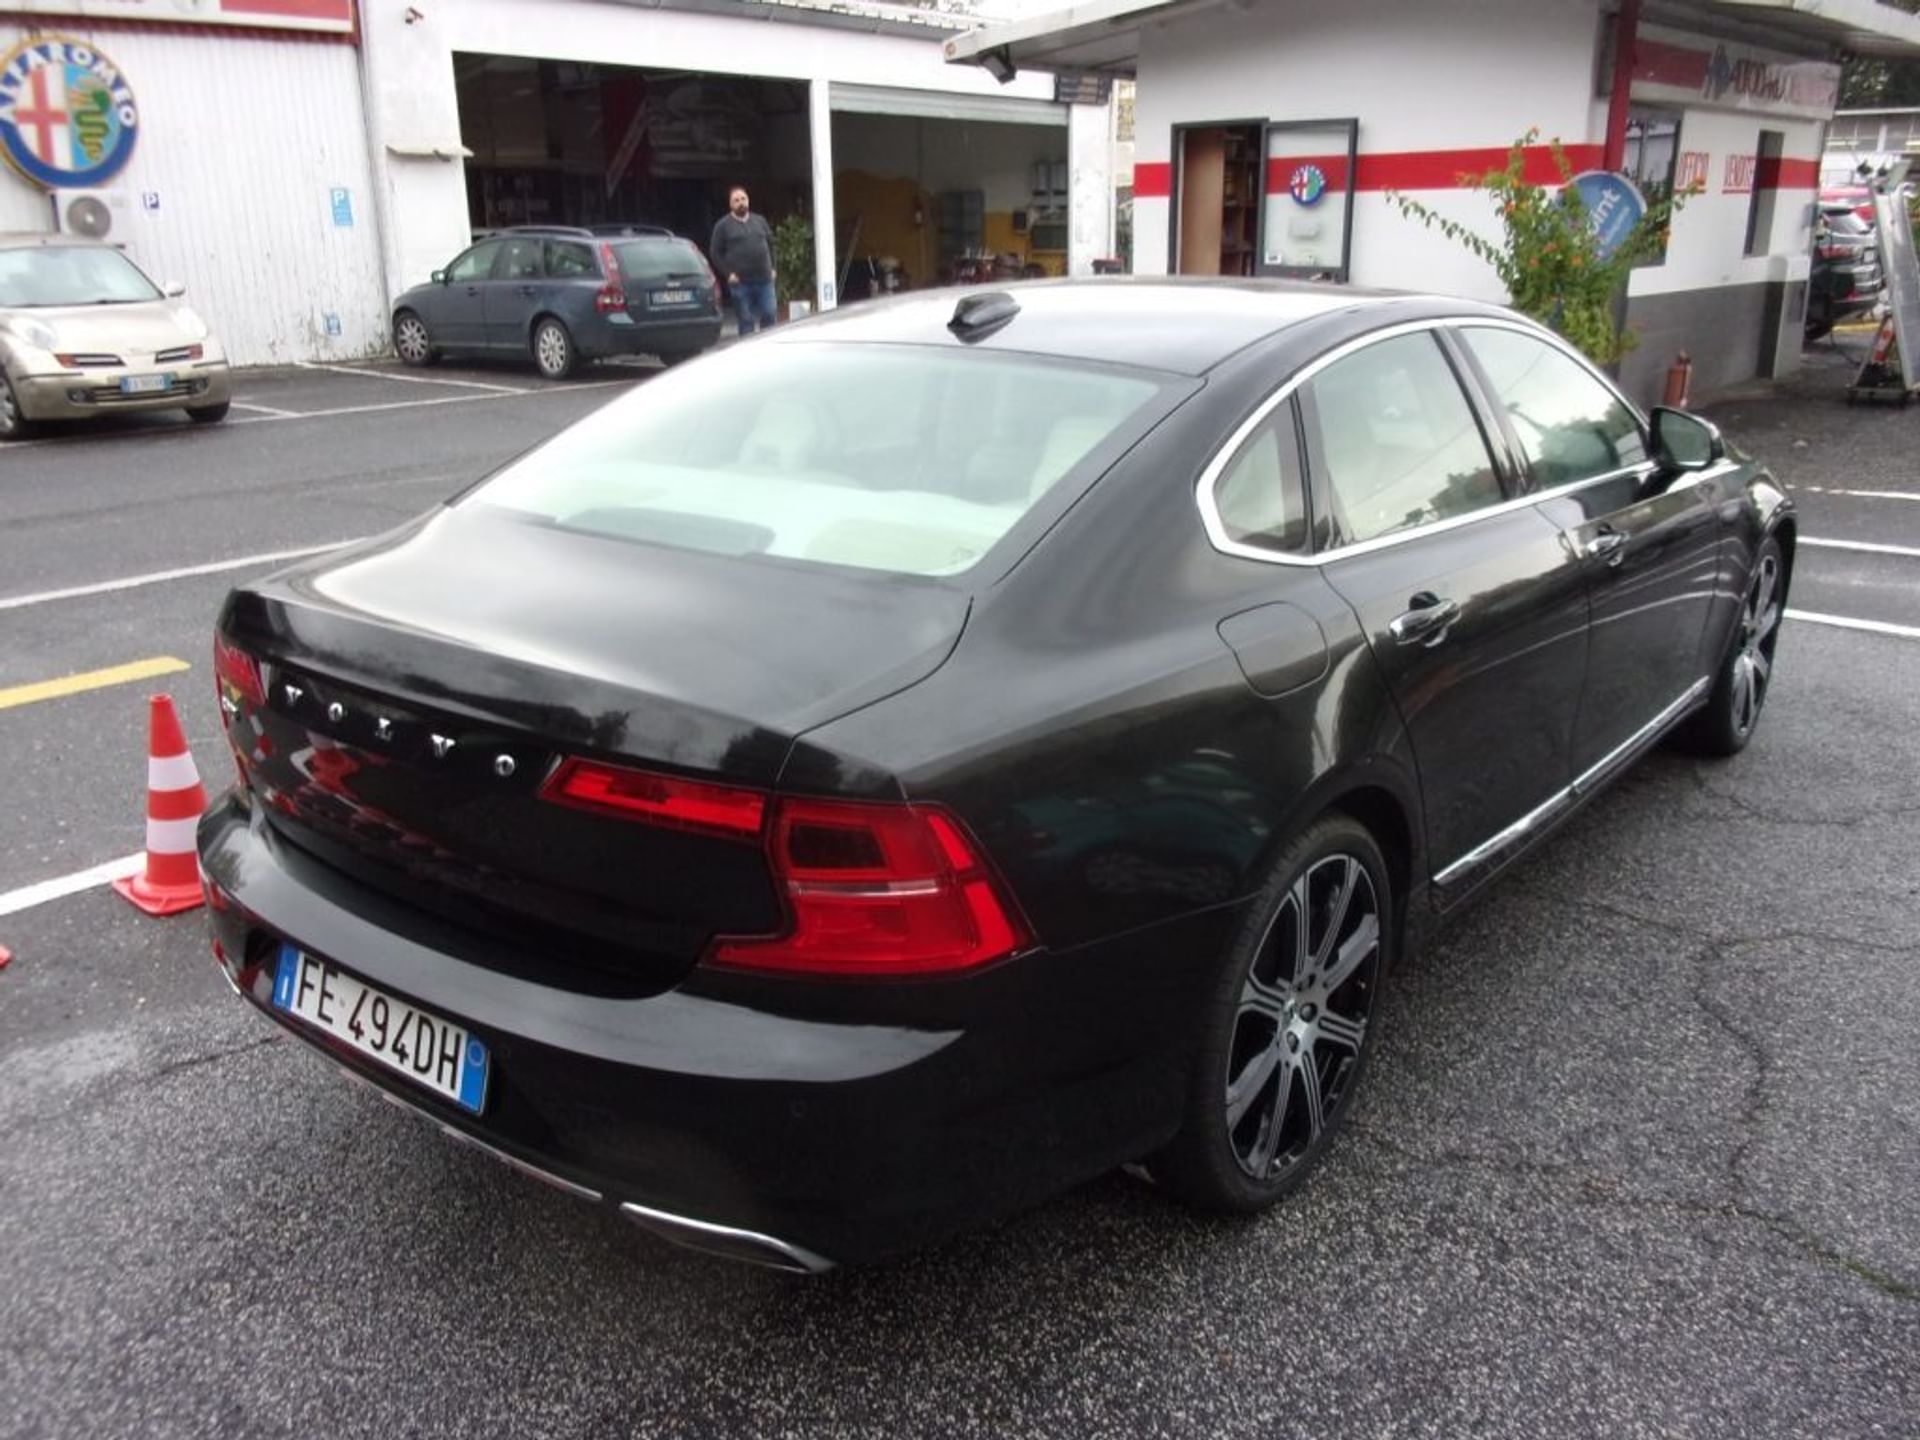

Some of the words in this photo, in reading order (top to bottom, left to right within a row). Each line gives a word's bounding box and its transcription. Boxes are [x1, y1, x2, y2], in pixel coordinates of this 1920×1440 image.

[285, 684, 516, 777] VOLVO
[297, 957, 339, 1024] FE
[348, 988, 462, 1091] 494DH
